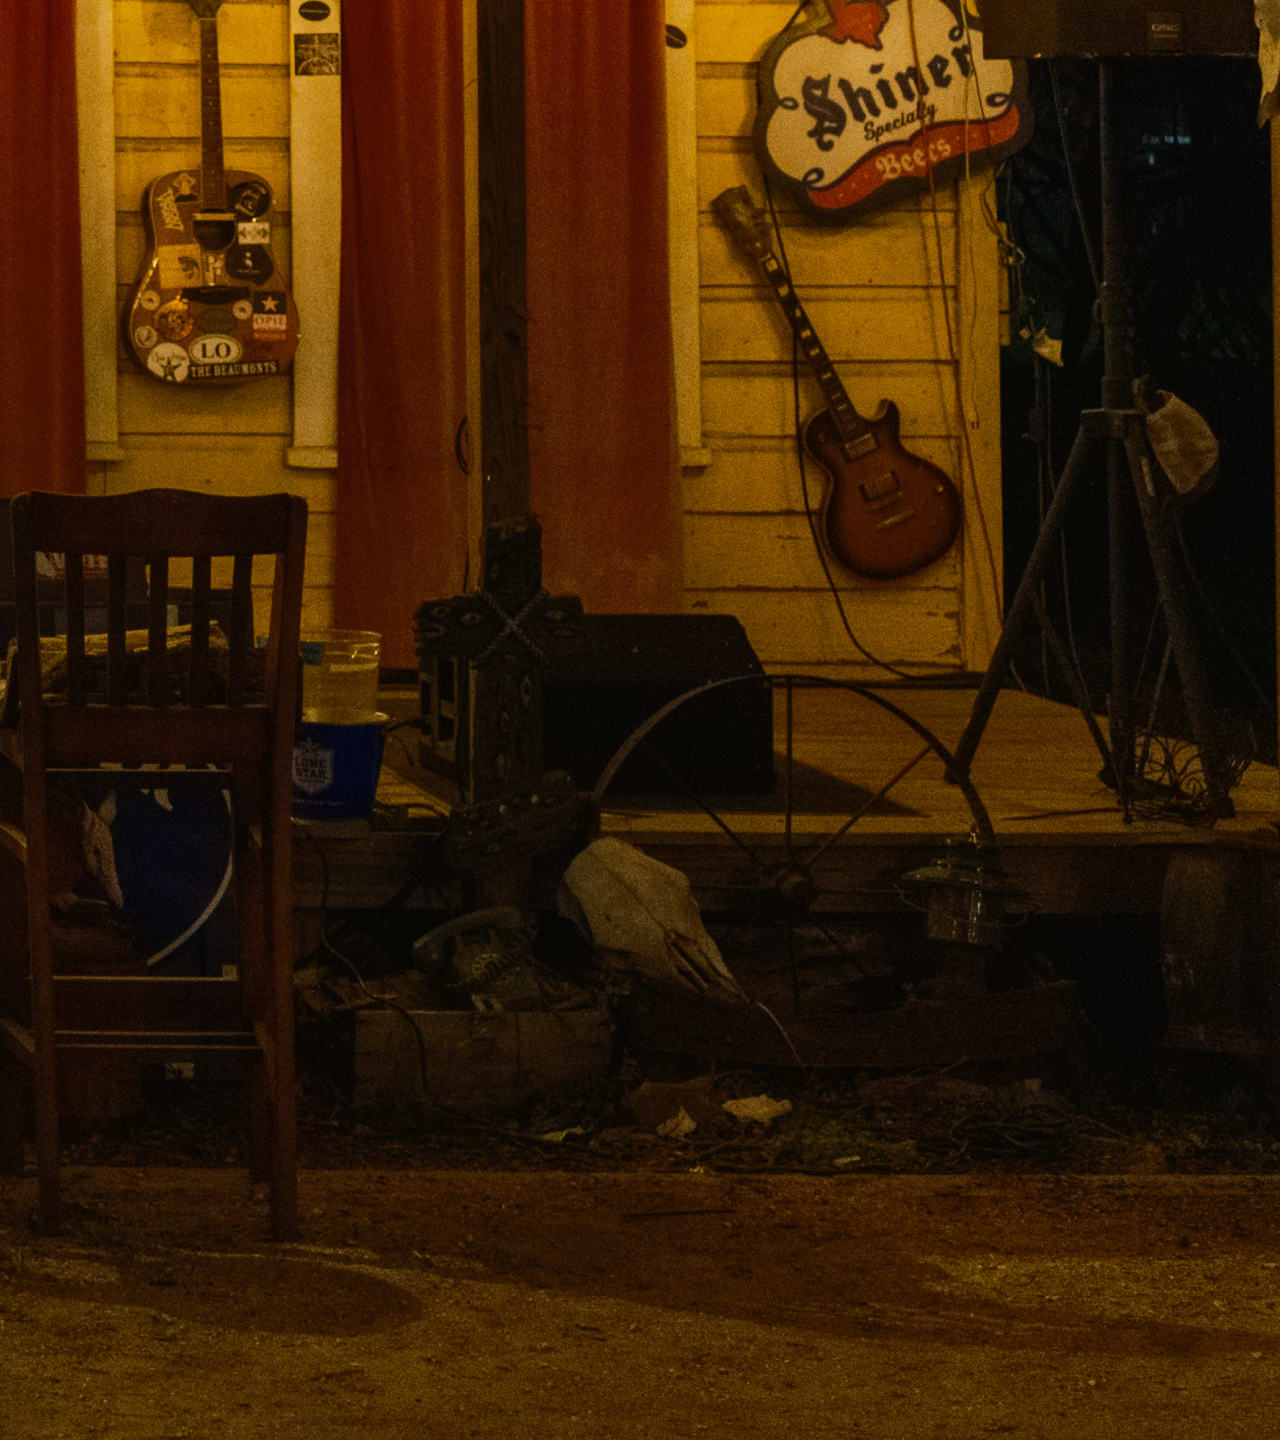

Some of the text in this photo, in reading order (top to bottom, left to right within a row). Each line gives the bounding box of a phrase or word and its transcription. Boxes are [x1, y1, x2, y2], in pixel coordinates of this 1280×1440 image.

[801, 44, 973, 152] Shiner
[863, 100, 938, 143] Specialty
[874, 139, 952, 180] Beers
